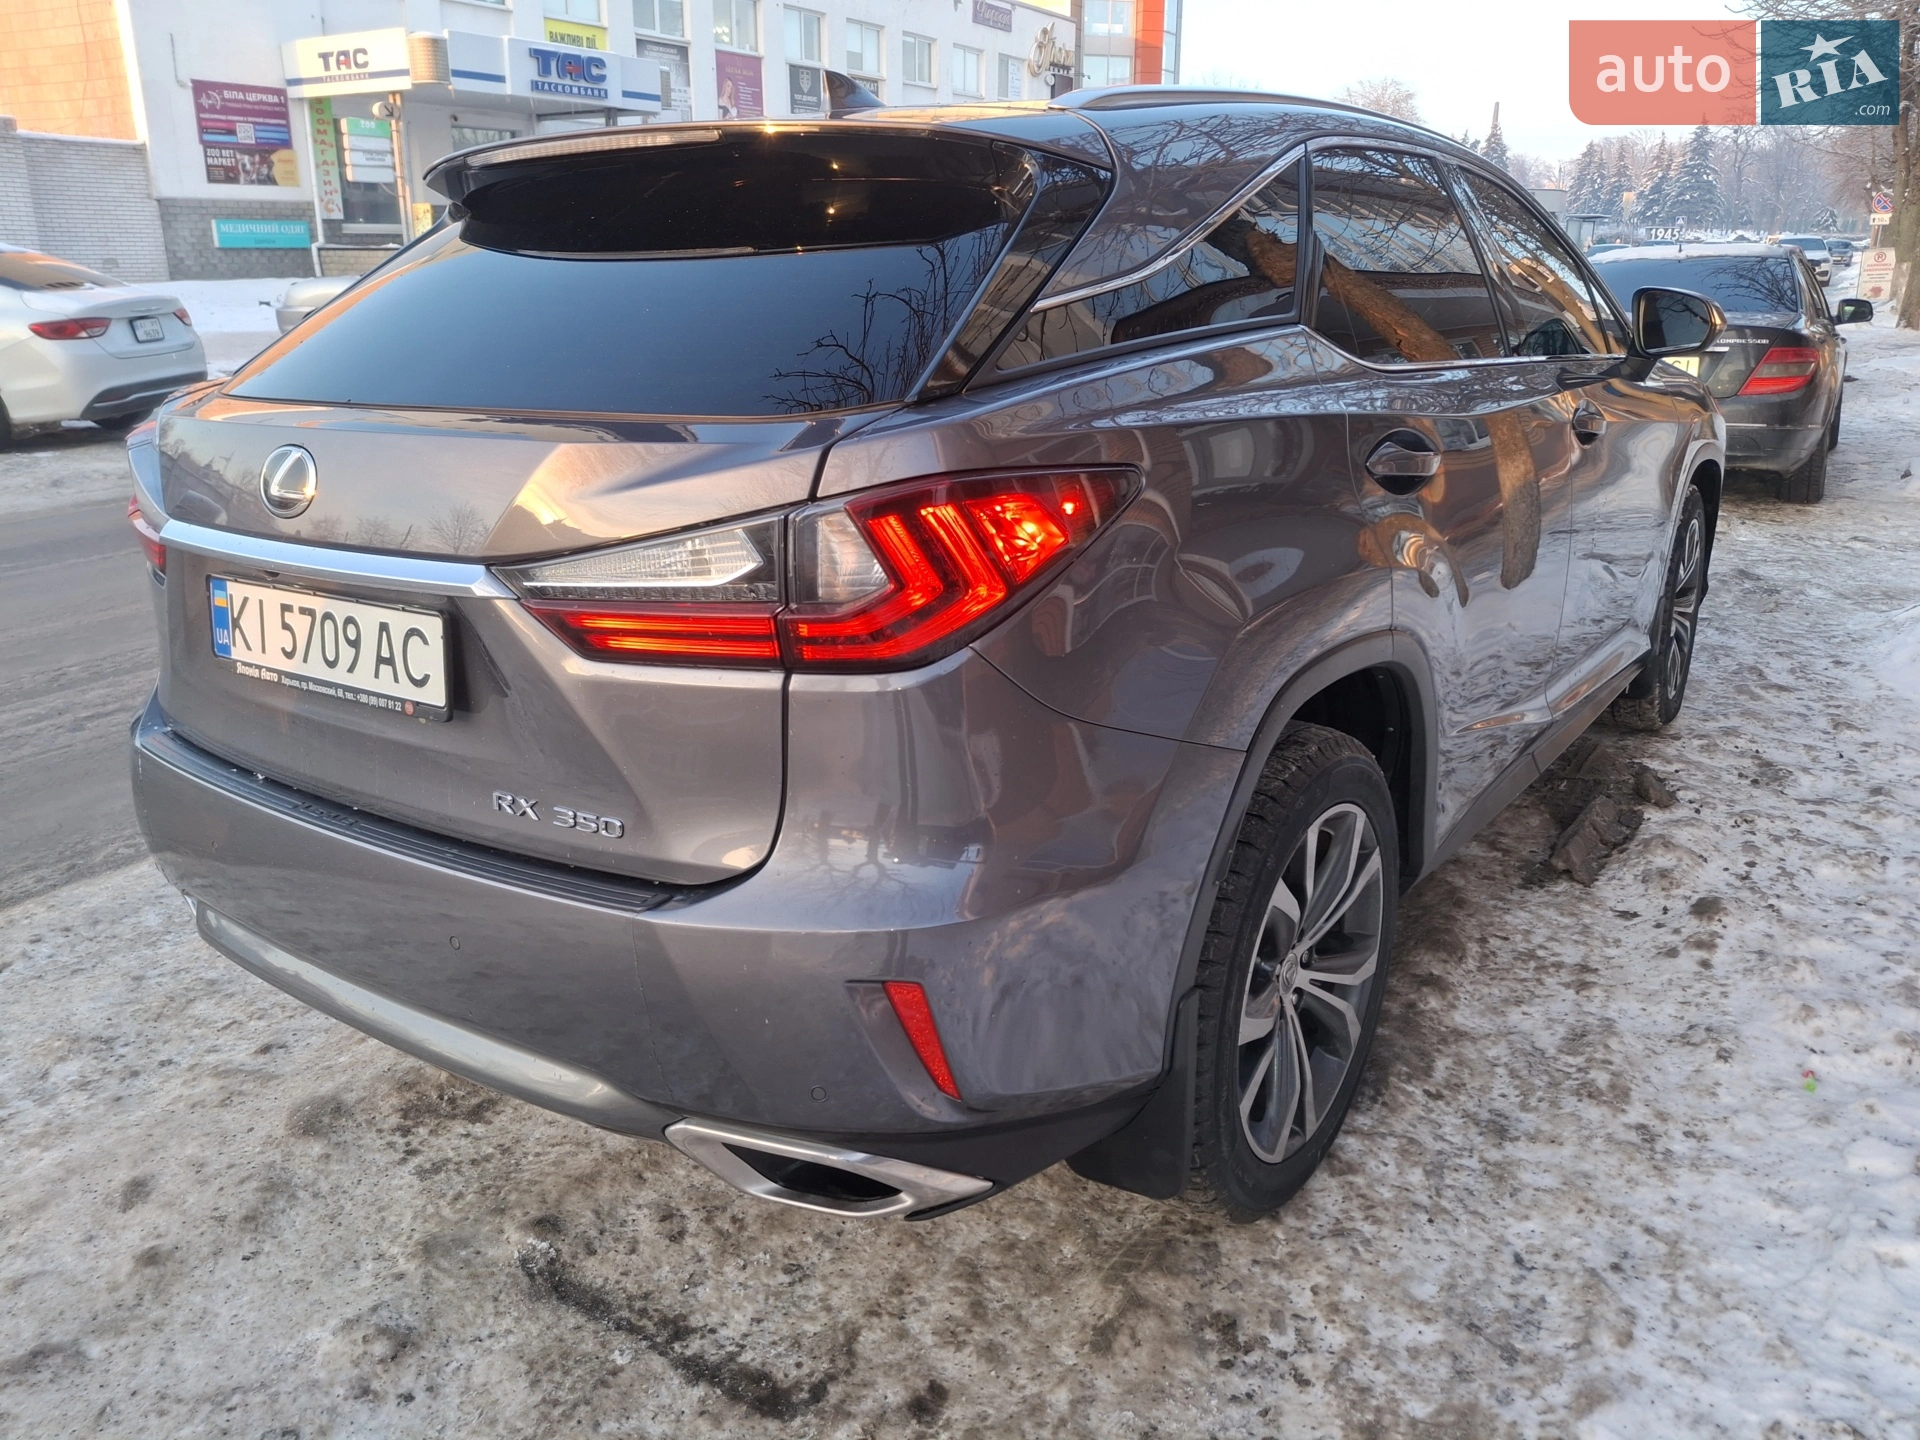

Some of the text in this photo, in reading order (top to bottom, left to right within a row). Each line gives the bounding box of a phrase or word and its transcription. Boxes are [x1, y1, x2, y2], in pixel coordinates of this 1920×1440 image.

[549, 31, 583, 46] ВАЖЛИВІ
[323, 73, 370, 82] ТАСКОМБАНК
[223, 90, 245, 100] БІЛА
[245, 92, 279, 104] ЦЕРКВА
[537, 82, 606, 97] ТАСКОМБАНК
[207, 157, 236, 166] МАРКЕТ
[220, 223, 279, 234] МЕДИЧНИЙ
[1650, 228, 1680, 241] 1945
[216, 628, 230, 645] UA
[229, 592, 431, 689] KI 5709 AC
[260, 667, 278, 682] Авто
[493, 790, 625, 839] RX 350
